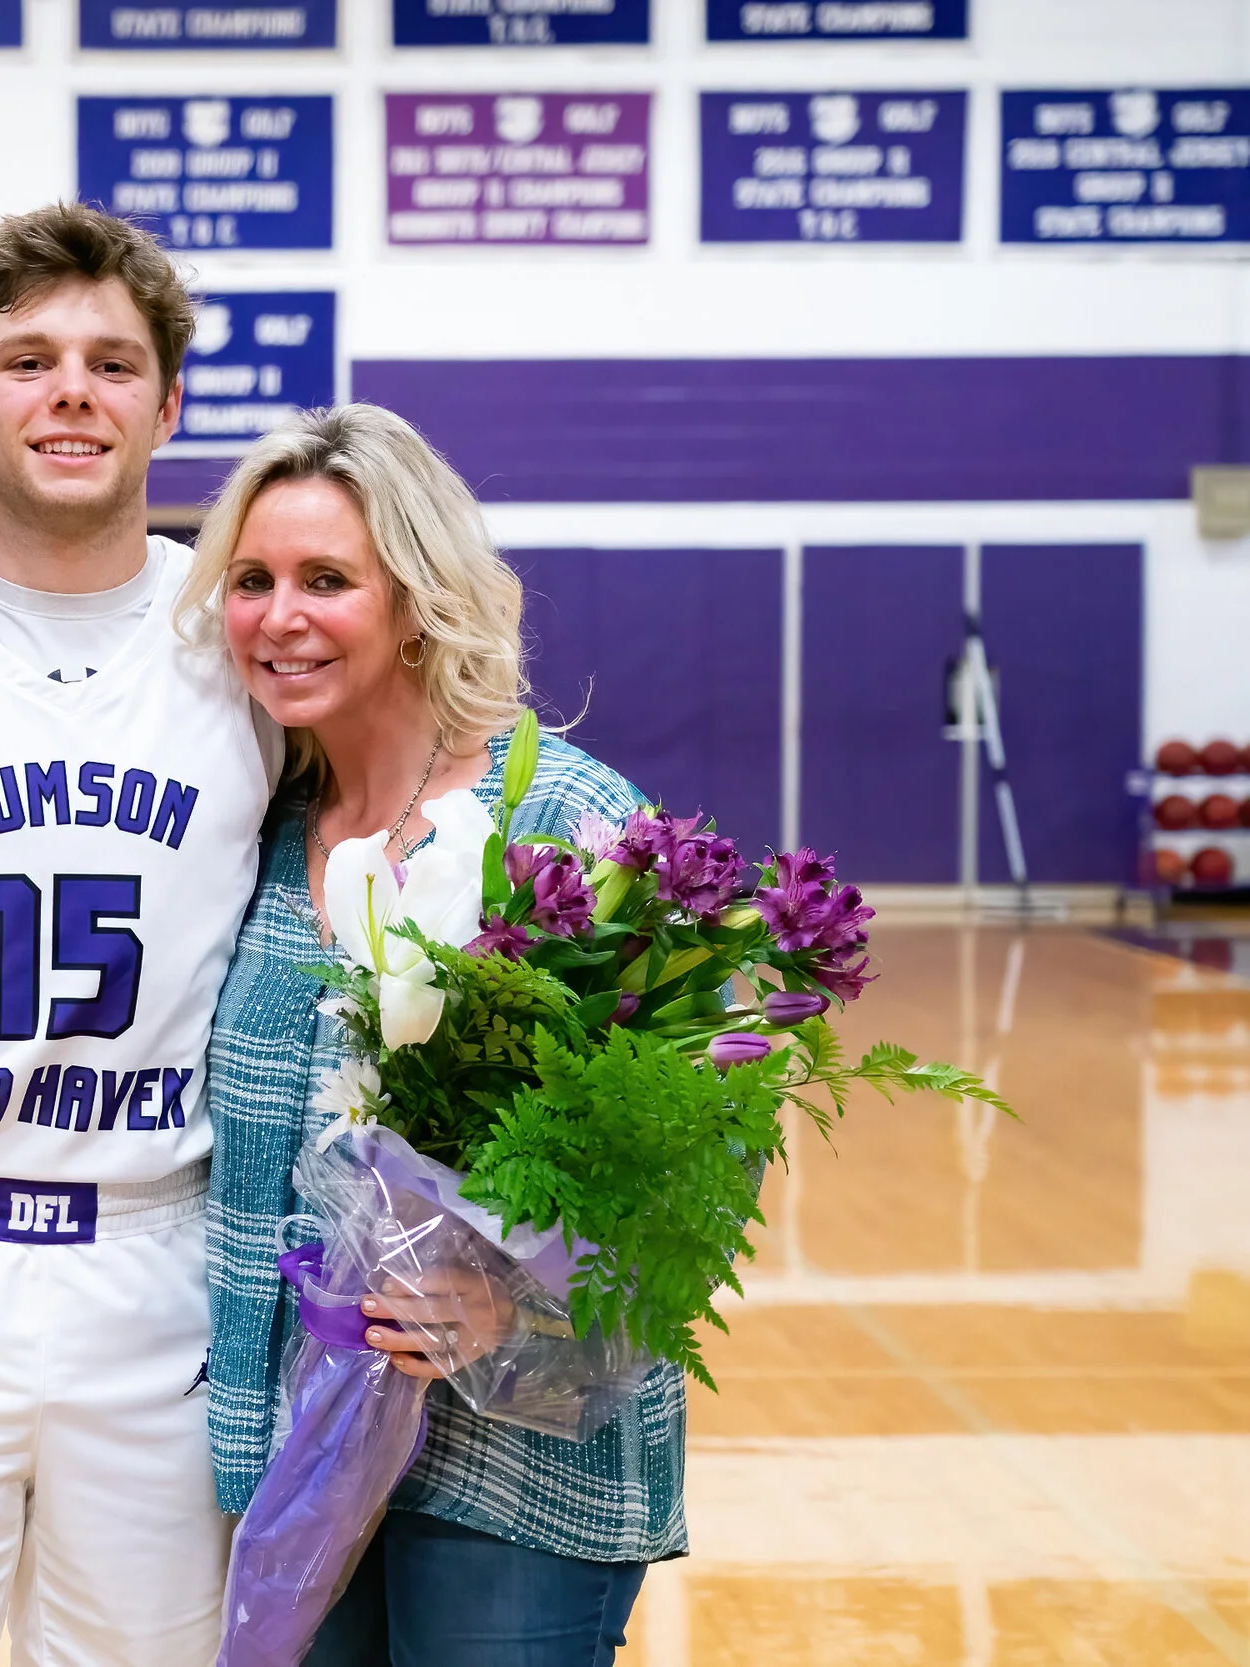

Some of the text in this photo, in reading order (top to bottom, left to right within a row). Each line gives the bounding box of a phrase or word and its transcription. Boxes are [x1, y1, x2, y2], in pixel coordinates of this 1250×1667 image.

[740, 1, 934, 34] STATE CHAMPIONS
[17, 1064, 195, 1132] HAVEN
[7, 1192, 79, 1233] DFL
